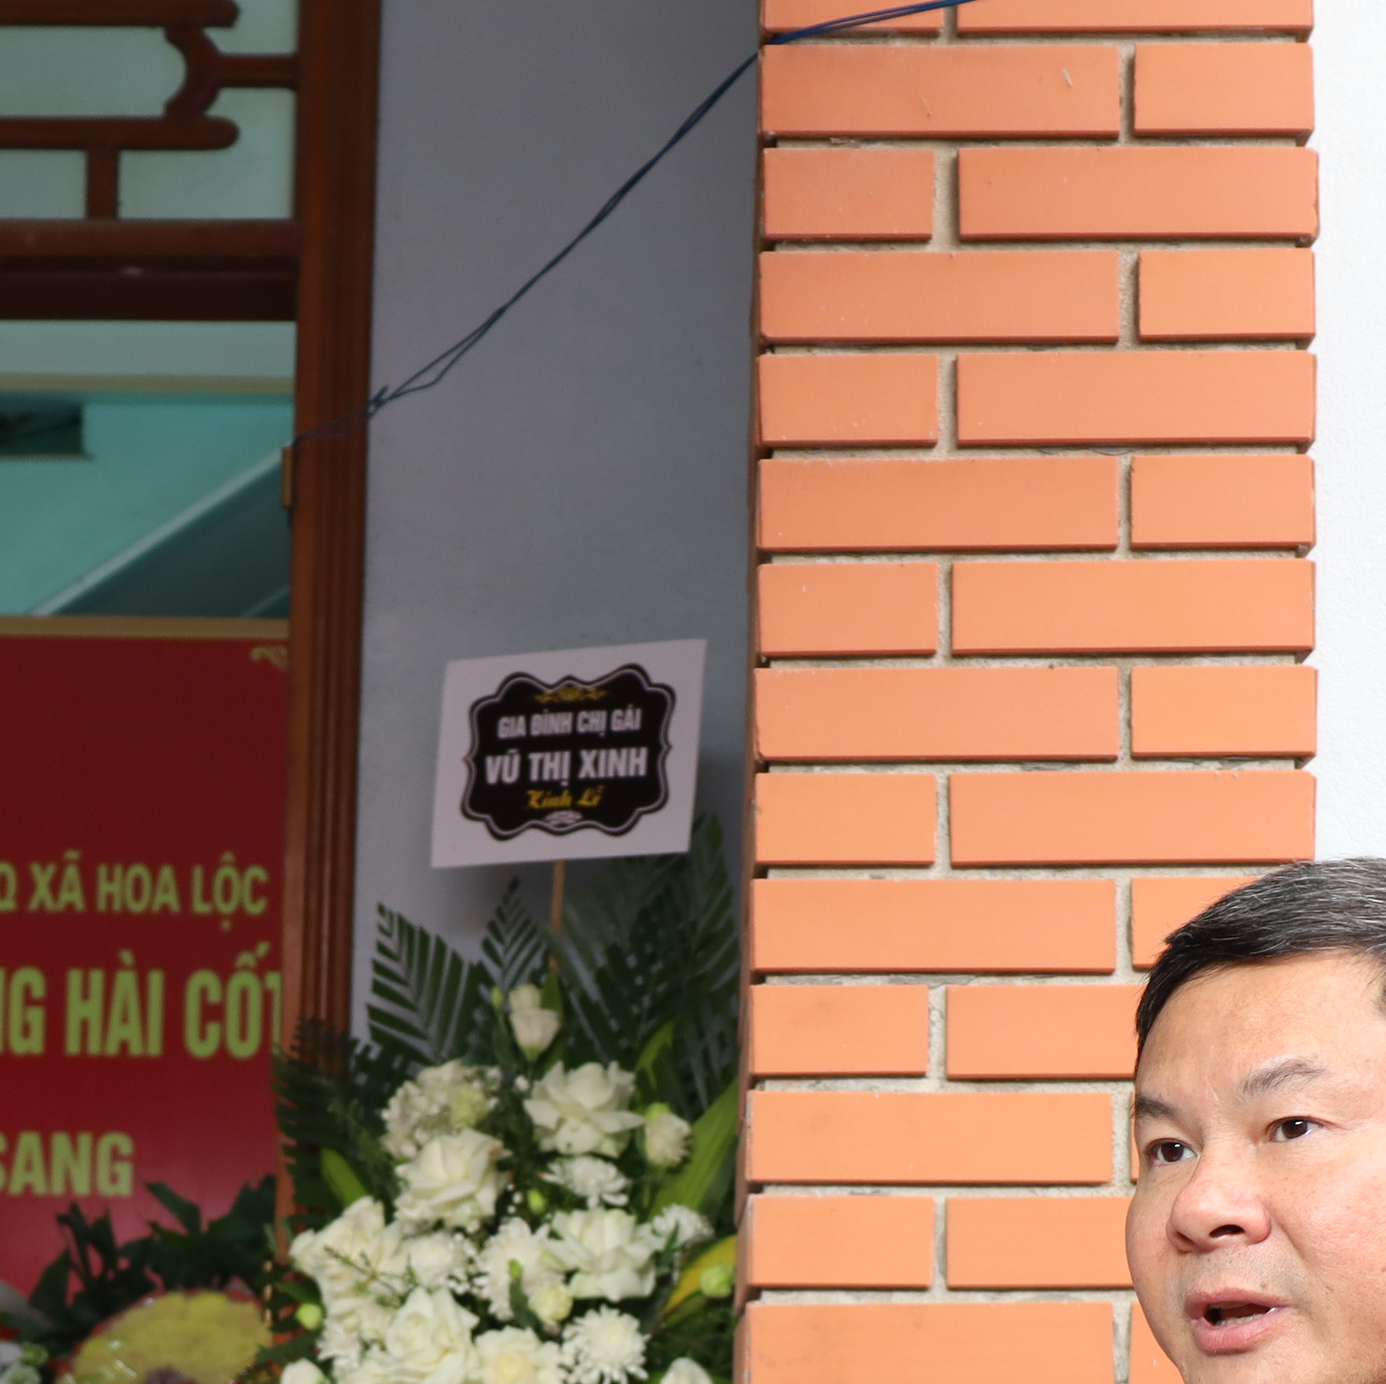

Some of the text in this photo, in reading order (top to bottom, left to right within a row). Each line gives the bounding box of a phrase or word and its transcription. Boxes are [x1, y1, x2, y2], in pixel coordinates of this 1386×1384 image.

[497, 704, 643, 740] GIA ĐÌNH CHỊ GÁI
[485, 747, 649, 787] VŨ THỊ XINH
[27, 849, 86, 912] XÃ
[97, 863, 181, 914] HOA
[190, 850, 269, 932] LỘC
[64, 948, 164, 1058] HÀI
